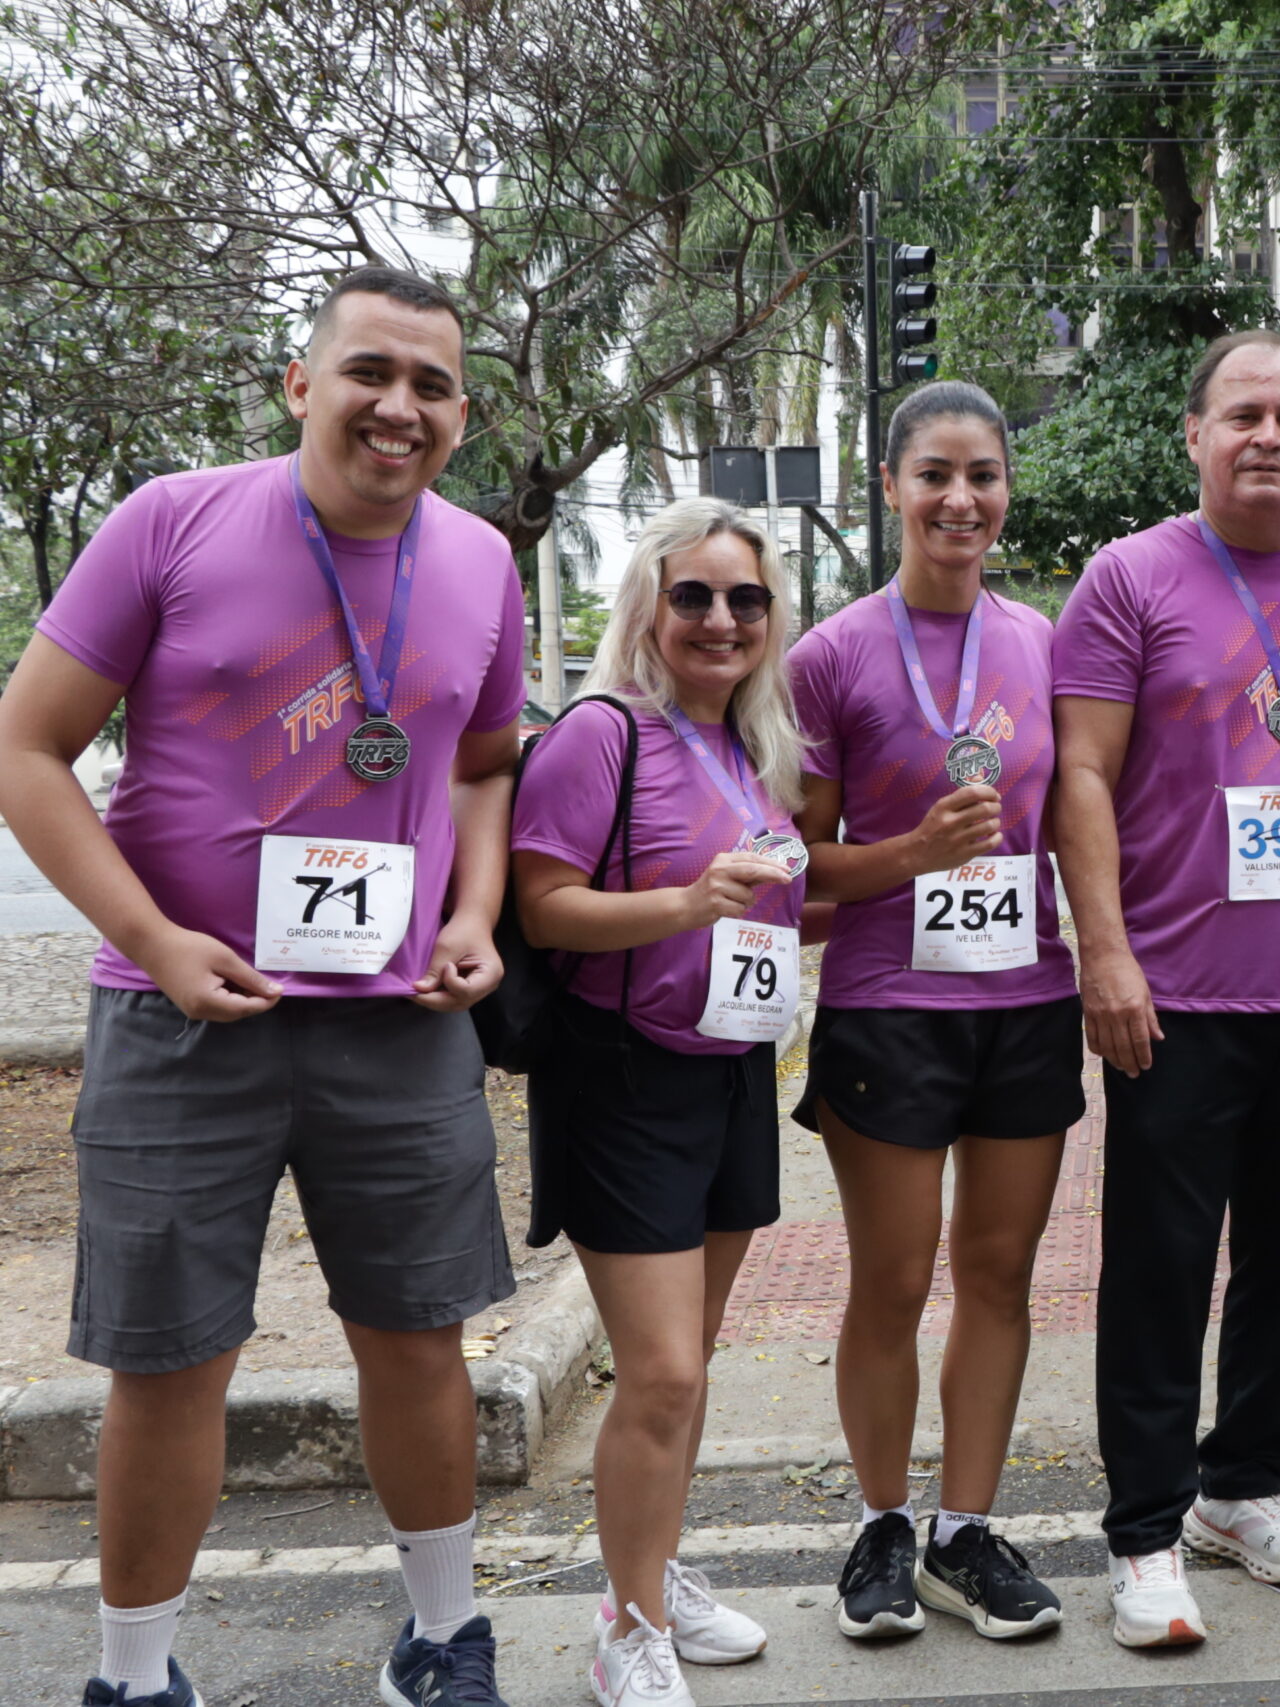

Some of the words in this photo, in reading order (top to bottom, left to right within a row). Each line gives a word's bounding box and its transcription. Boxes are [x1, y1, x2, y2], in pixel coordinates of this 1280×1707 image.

[287, 688, 317, 713] corrida
[317, 661, 353, 690] solidária
[347, 743, 410, 763] TRF6
[948, 749, 1000, 781] TRF6
[304, 848, 369, 870] TRF6
[296, 876, 367, 925] 71
[925, 888, 1023, 931] 254
[287, 928, 341, 939] GRÉGORE
[344, 931, 382, 940] MOURA
[737, 930, 773, 950] TRF6
[956, 935, 969, 943] IVE
[971, 934, 993, 943] LEITE
[732, 954, 777, 1001] 79
[718, 1001, 757, 1012] JACQUELINE
[758, 1004, 783, 1014] BEDRAN
